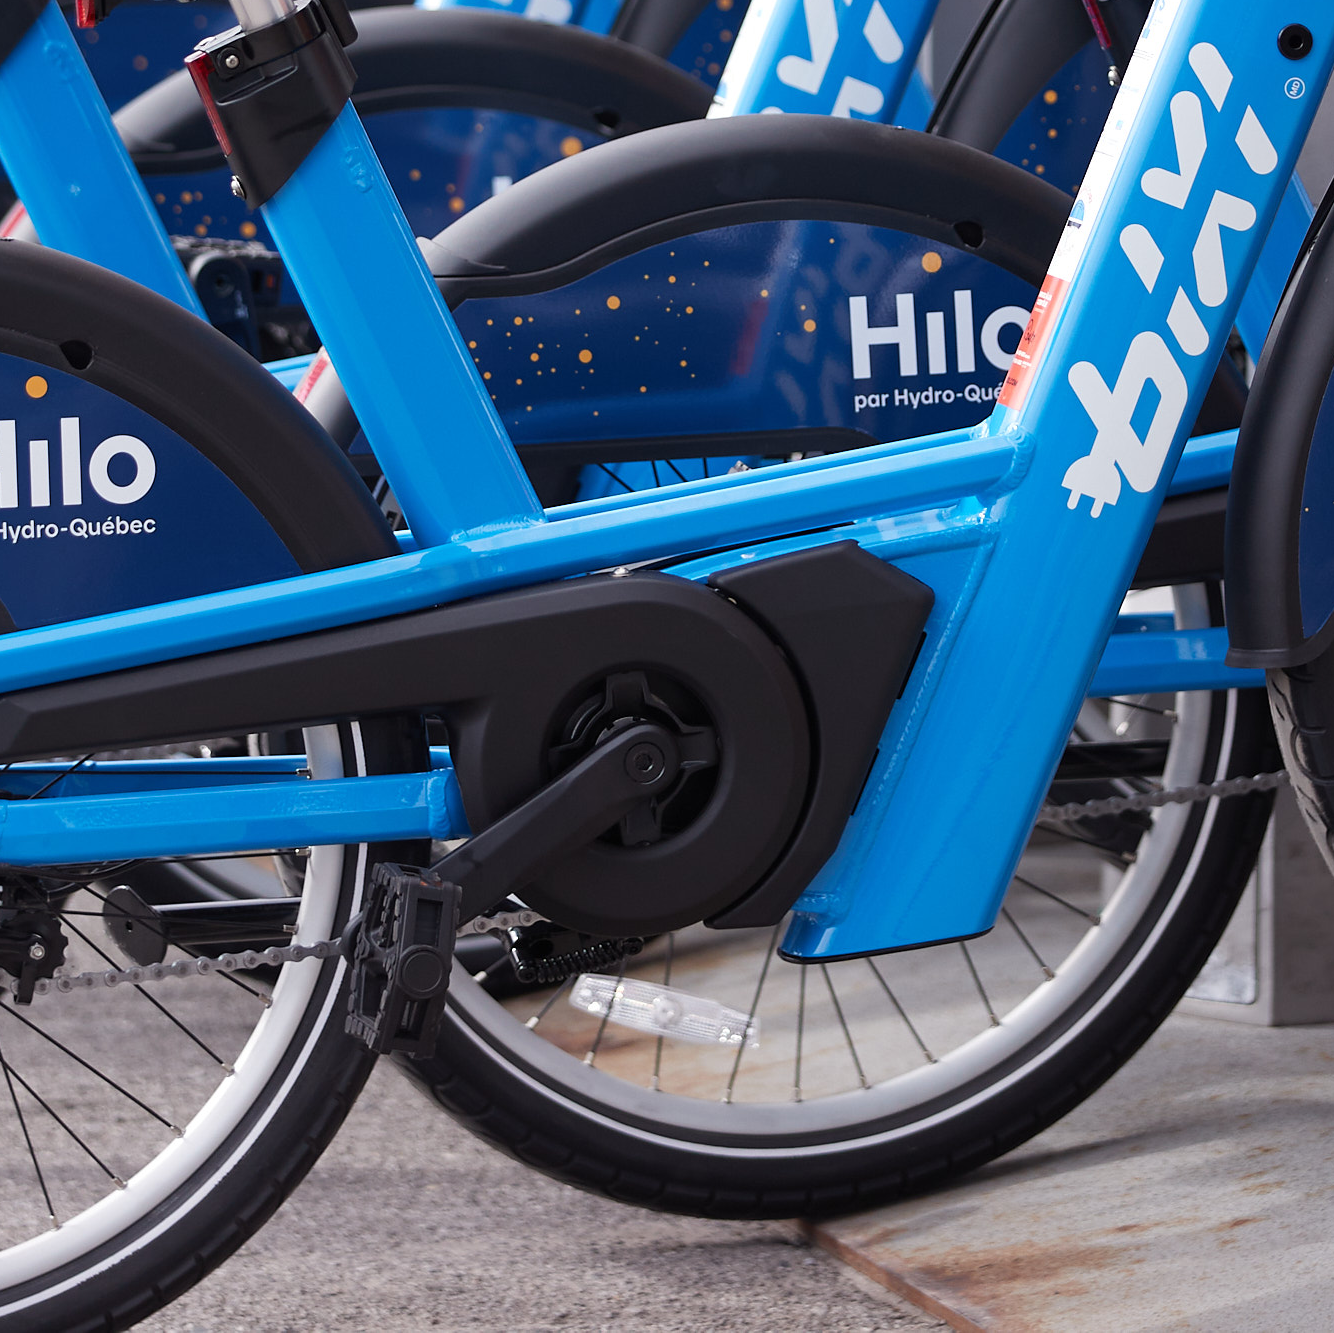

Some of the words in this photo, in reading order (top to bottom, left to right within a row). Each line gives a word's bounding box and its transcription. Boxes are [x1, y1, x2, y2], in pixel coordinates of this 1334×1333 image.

[848, 289, 1031, 380] Hilo
[854, 393, 889, 413] par
[894, 381, 1002, 410] Hydro-Qué
